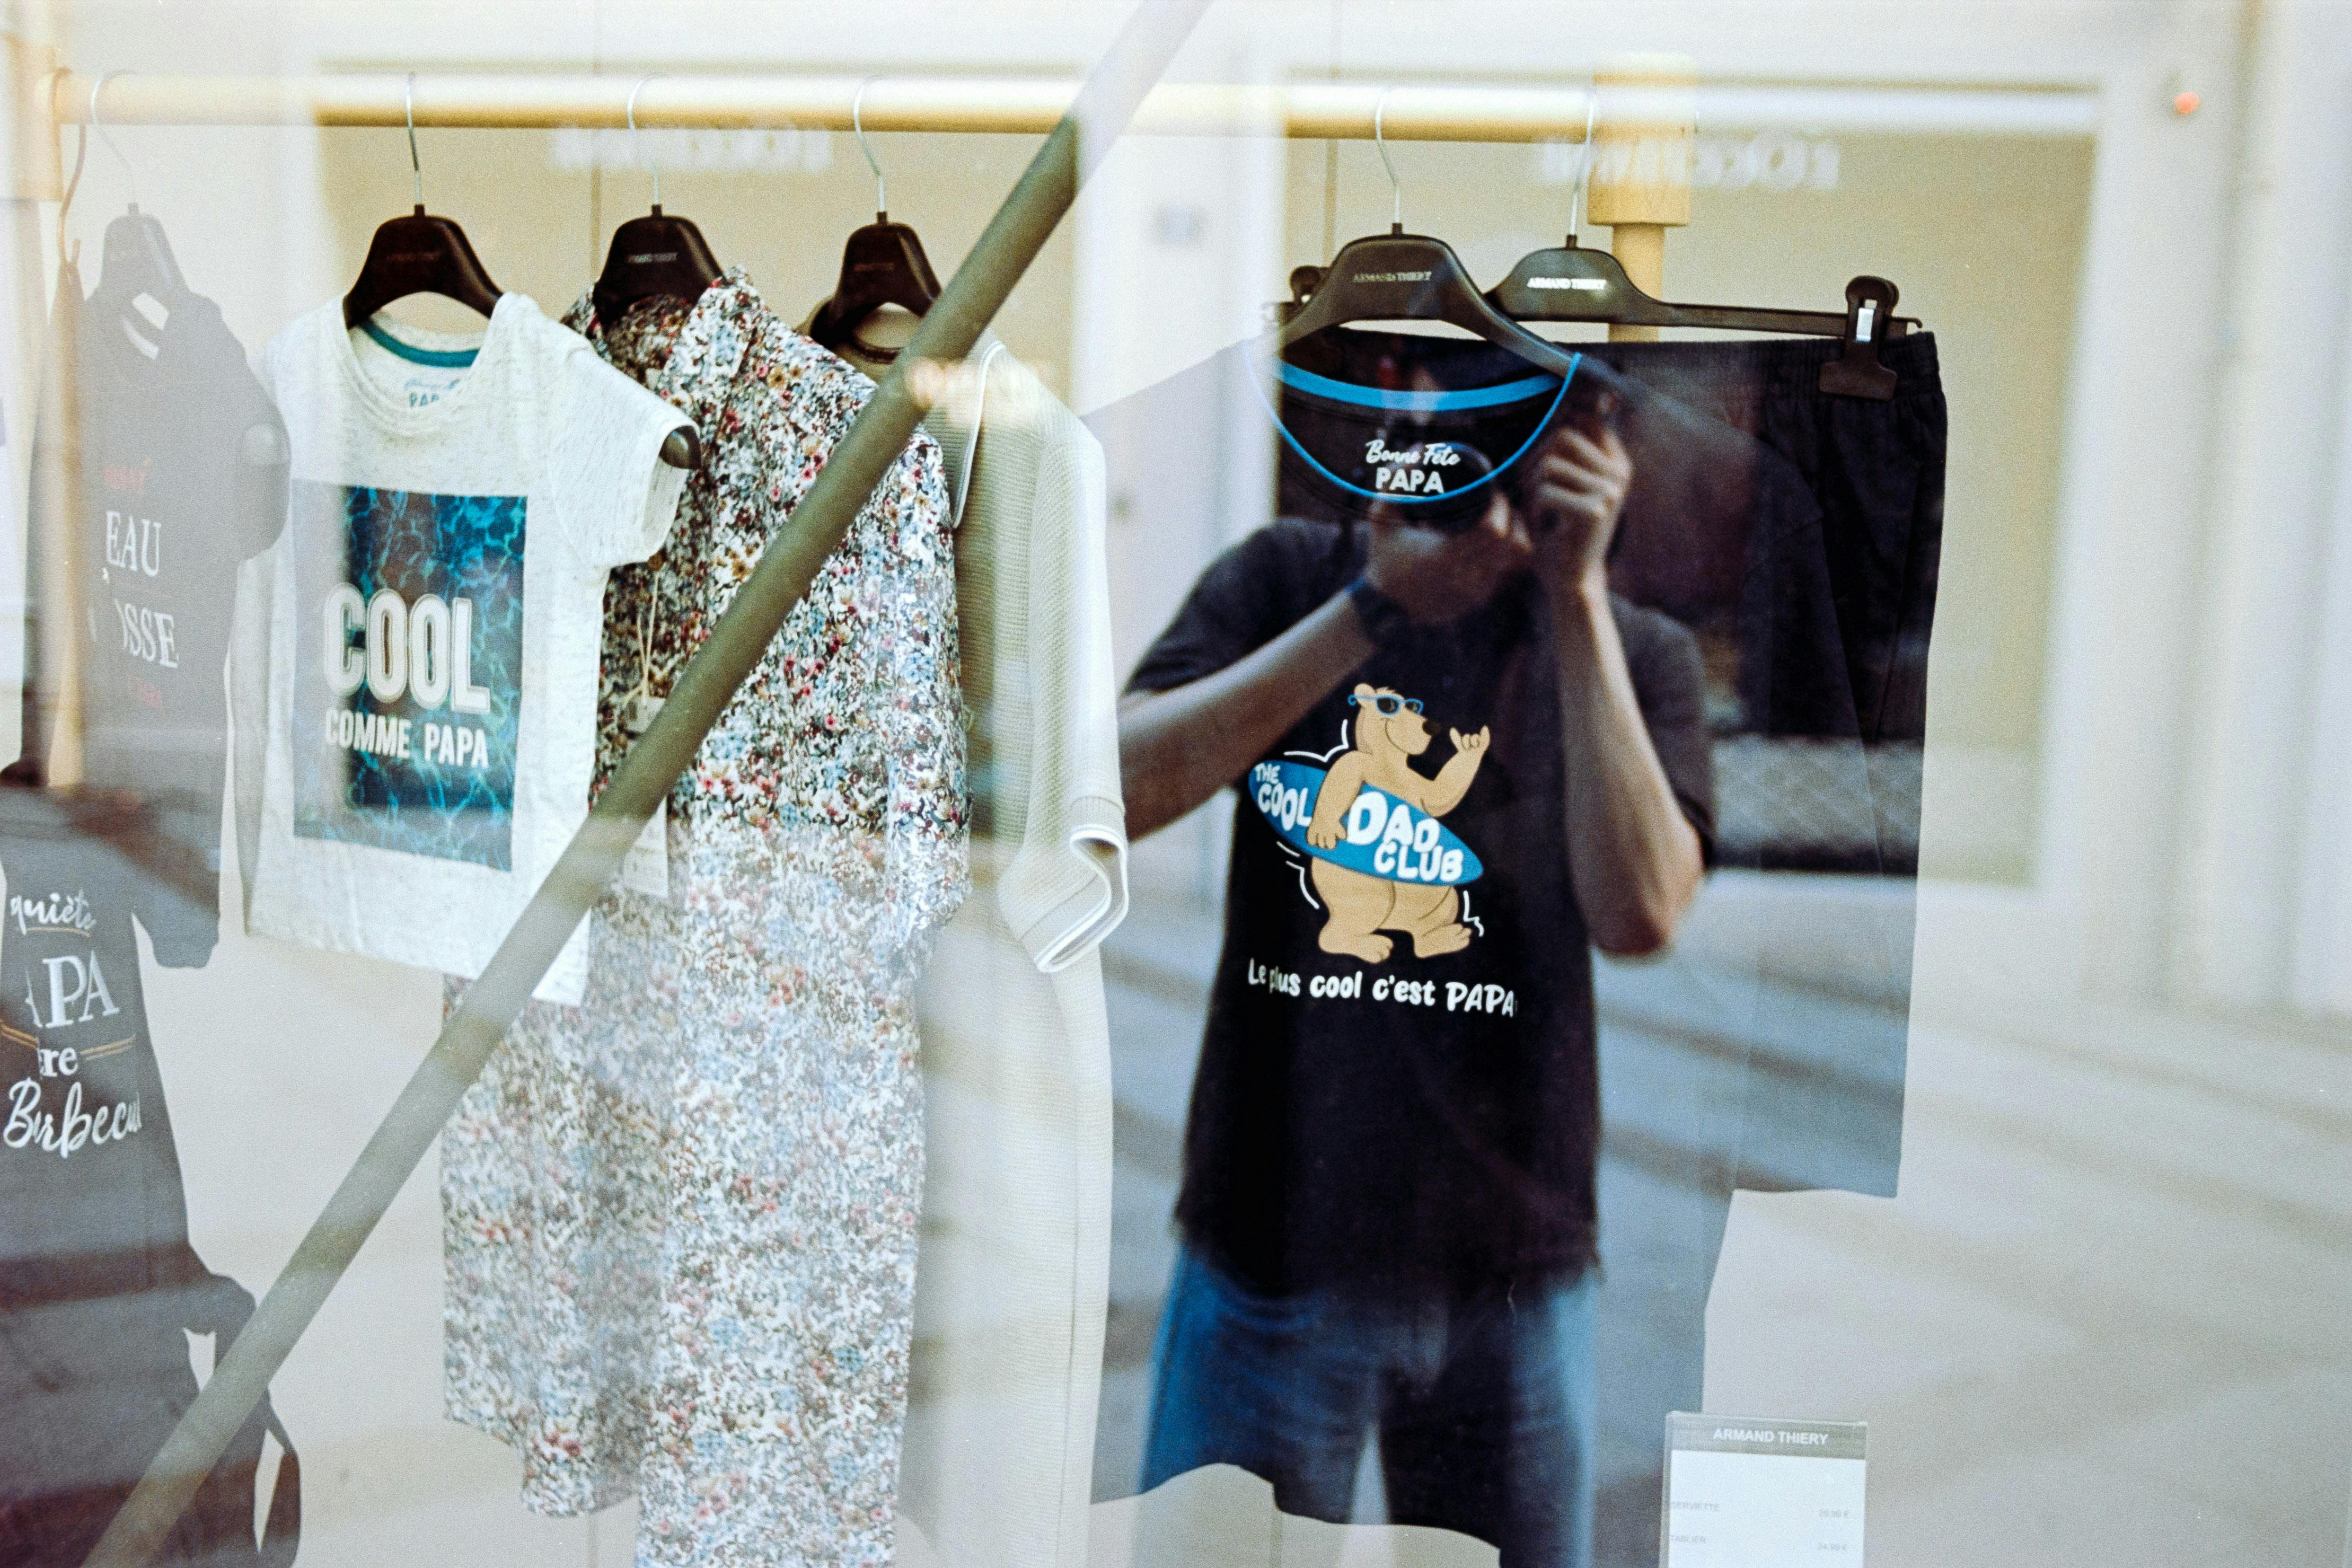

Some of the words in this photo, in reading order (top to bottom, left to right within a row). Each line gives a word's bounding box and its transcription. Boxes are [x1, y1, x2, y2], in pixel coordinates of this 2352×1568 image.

[409, 392, 440, 408] PAP
[1365, 438, 1422, 464] Bonne
[1375, 466, 1445, 495] PAPA
[106, 510, 162, 577] EAU
[321, 582, 490, 716] COOL
[325, 706, 411, 759] COMME
[425, 723, 489, 770] PAPA
[1254, 762, 1281, 785] THE
[1257, 782, 1312, 831] COOL
[1346, 791, 1440, 853] DAD
[1373, 840, 1464, 883] CLUB
[1248, 957, 1266, 985] Le
[1270, 966, 1301, 997] plus
[1309, 971, 1363, 999] cool
[1372, 974, 1436, 1006] c'est
[1445, 981, 1515, 1018] PAPA
[38, 1046, 79, 1078] re
[1713, 1429, 1774, 1442] ARMAND
[1777, 1431, 1829, 1446] THIERY
